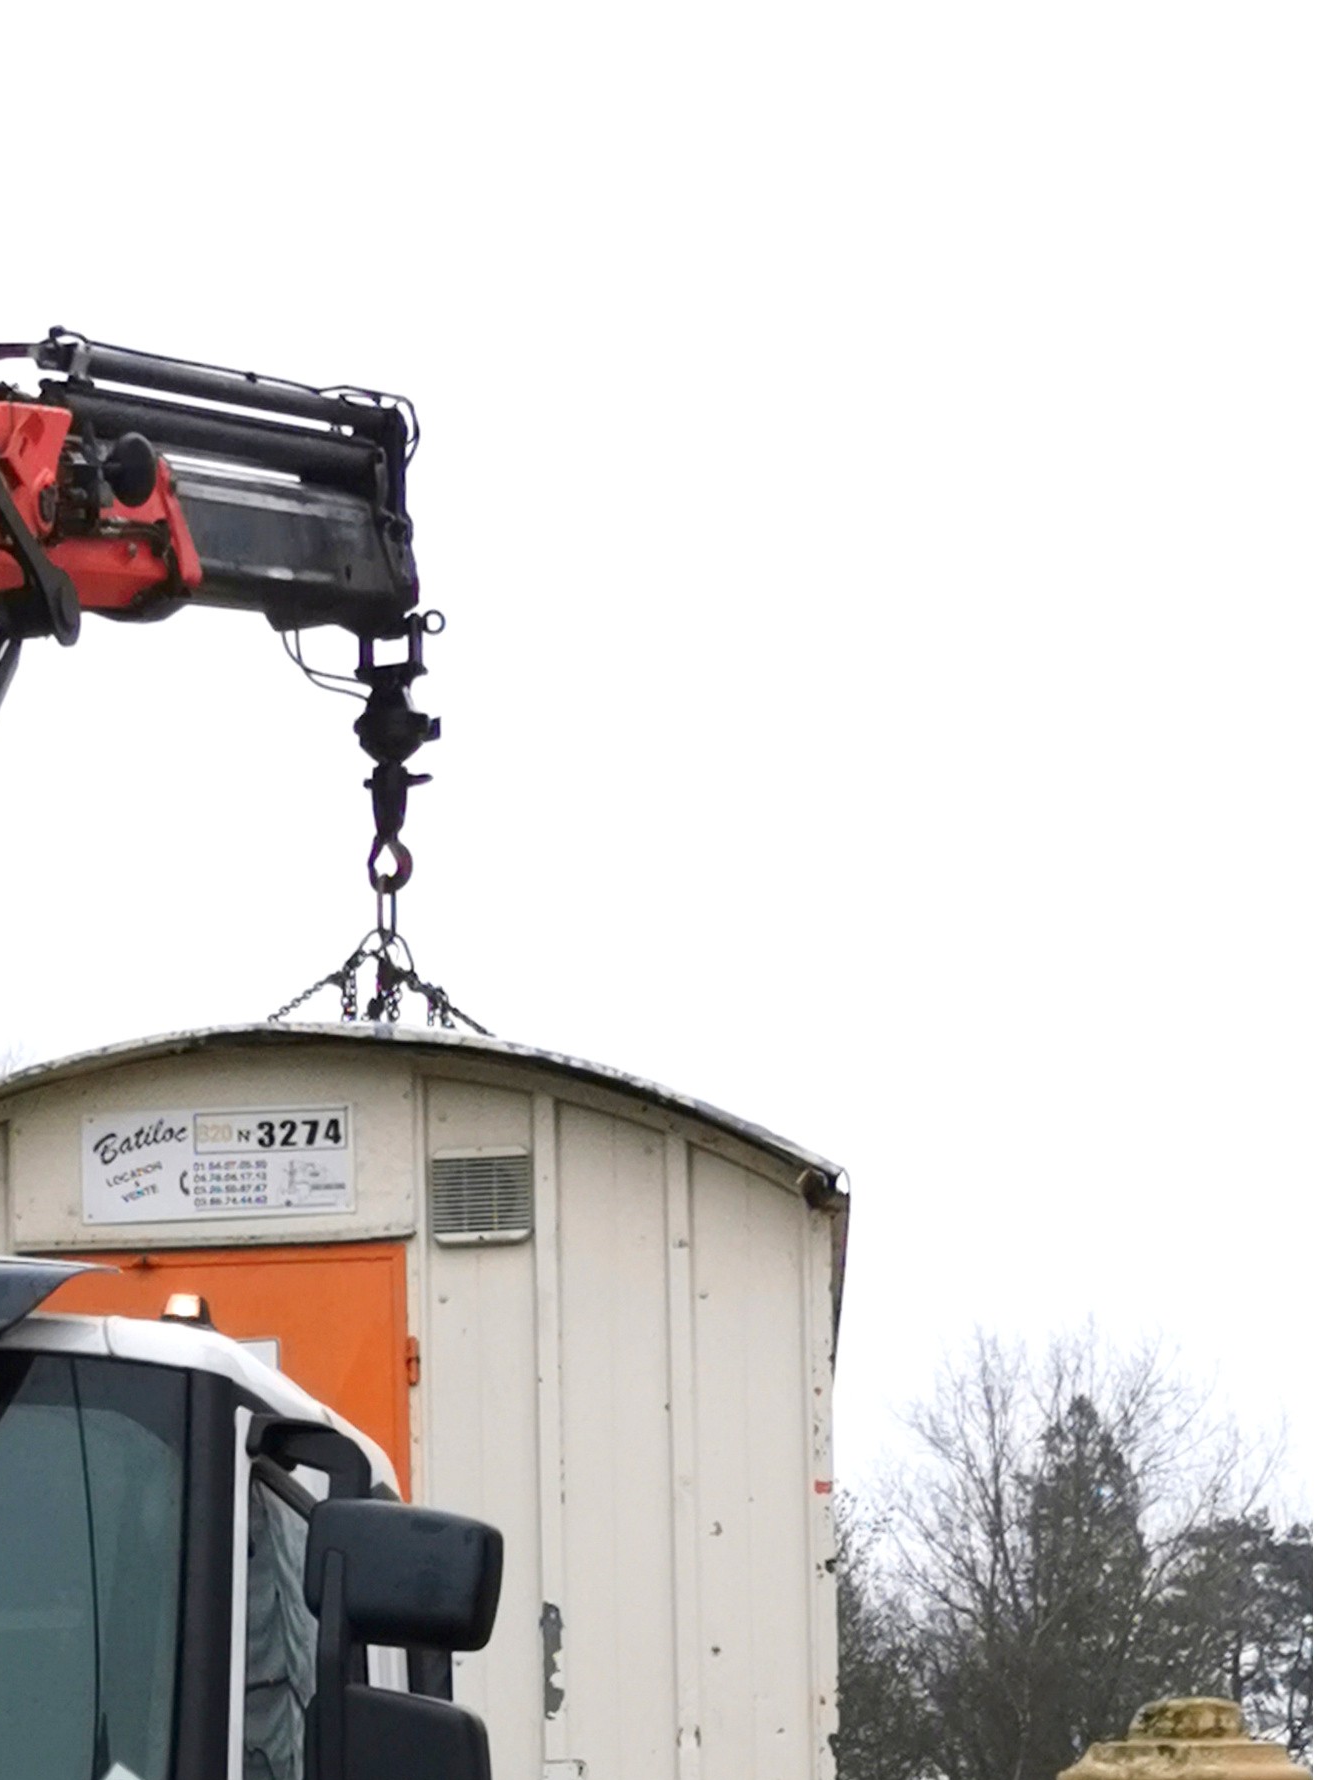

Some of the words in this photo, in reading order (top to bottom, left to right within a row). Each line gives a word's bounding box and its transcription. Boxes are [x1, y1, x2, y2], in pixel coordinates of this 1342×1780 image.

[92, 1118, 187, 1166] Batiloc
[257, 1118, 342, 1149] 3274
[106, 1161, 163, 1188] LOCATION
[121, 1183, 159, 1203] VENTE
